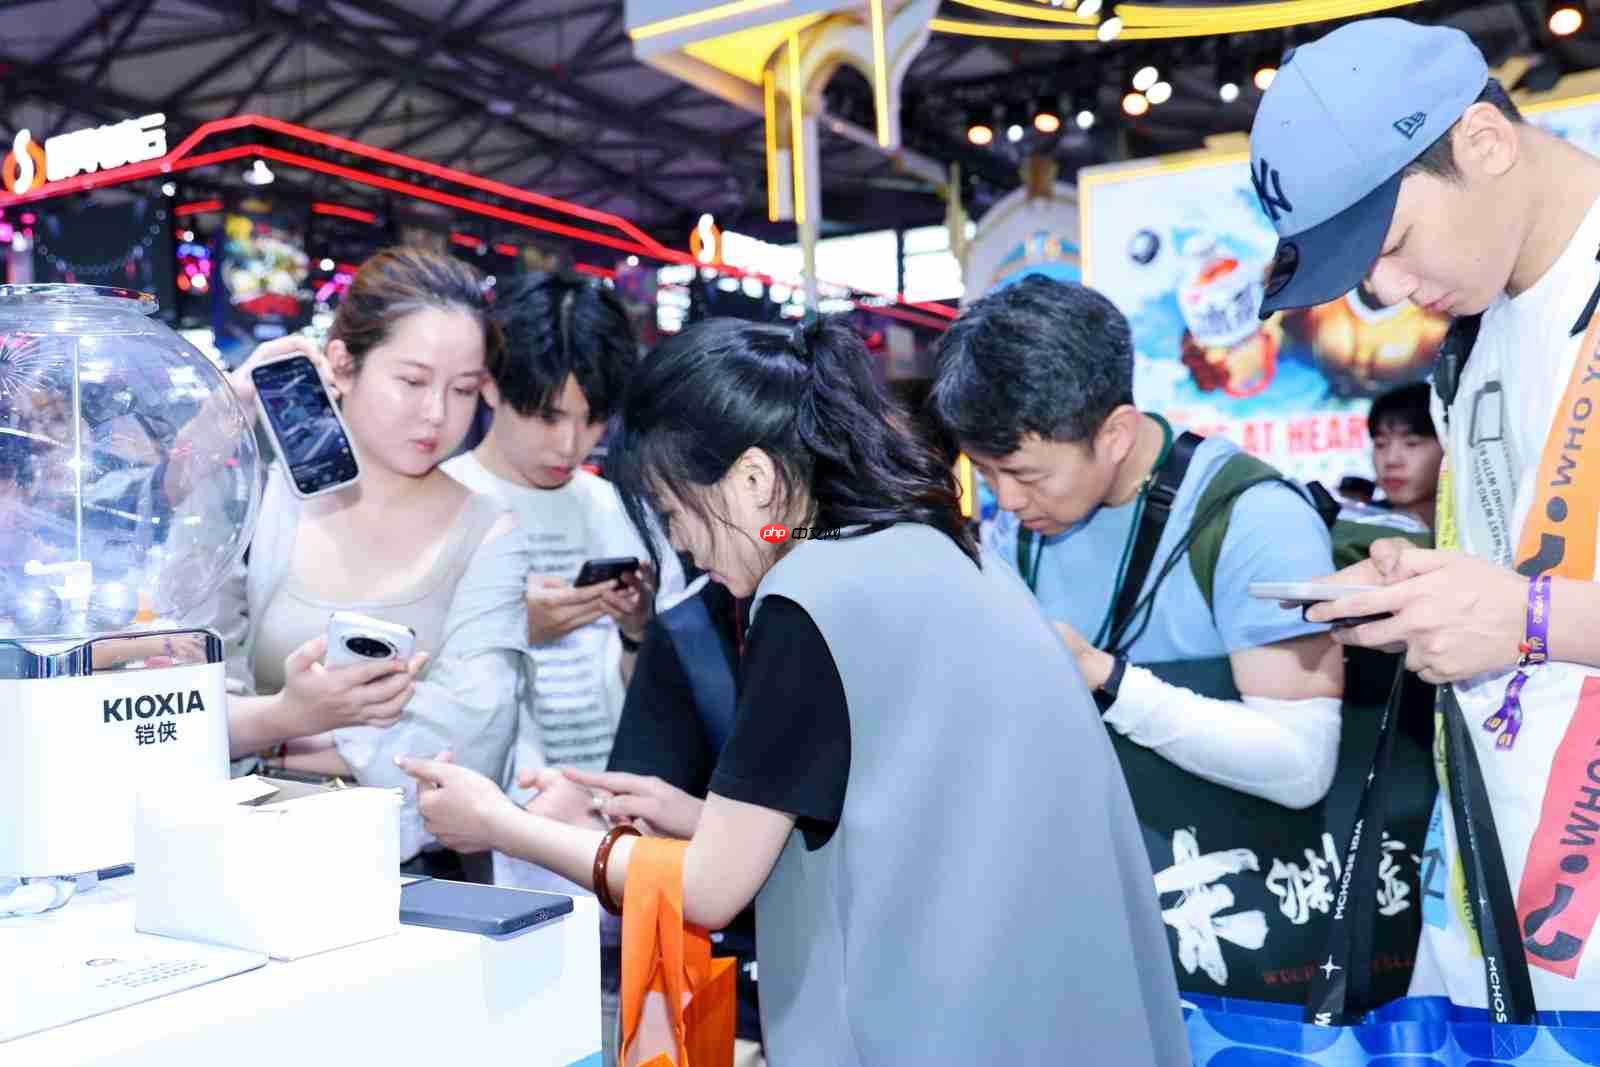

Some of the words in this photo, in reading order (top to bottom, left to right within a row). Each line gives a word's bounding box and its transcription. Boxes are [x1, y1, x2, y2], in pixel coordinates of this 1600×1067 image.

[1550, 396, 1593, 487] WHO
[103, 690, 205, 723] KIOXIA
[135, 721, 177, 746] 铠侠
